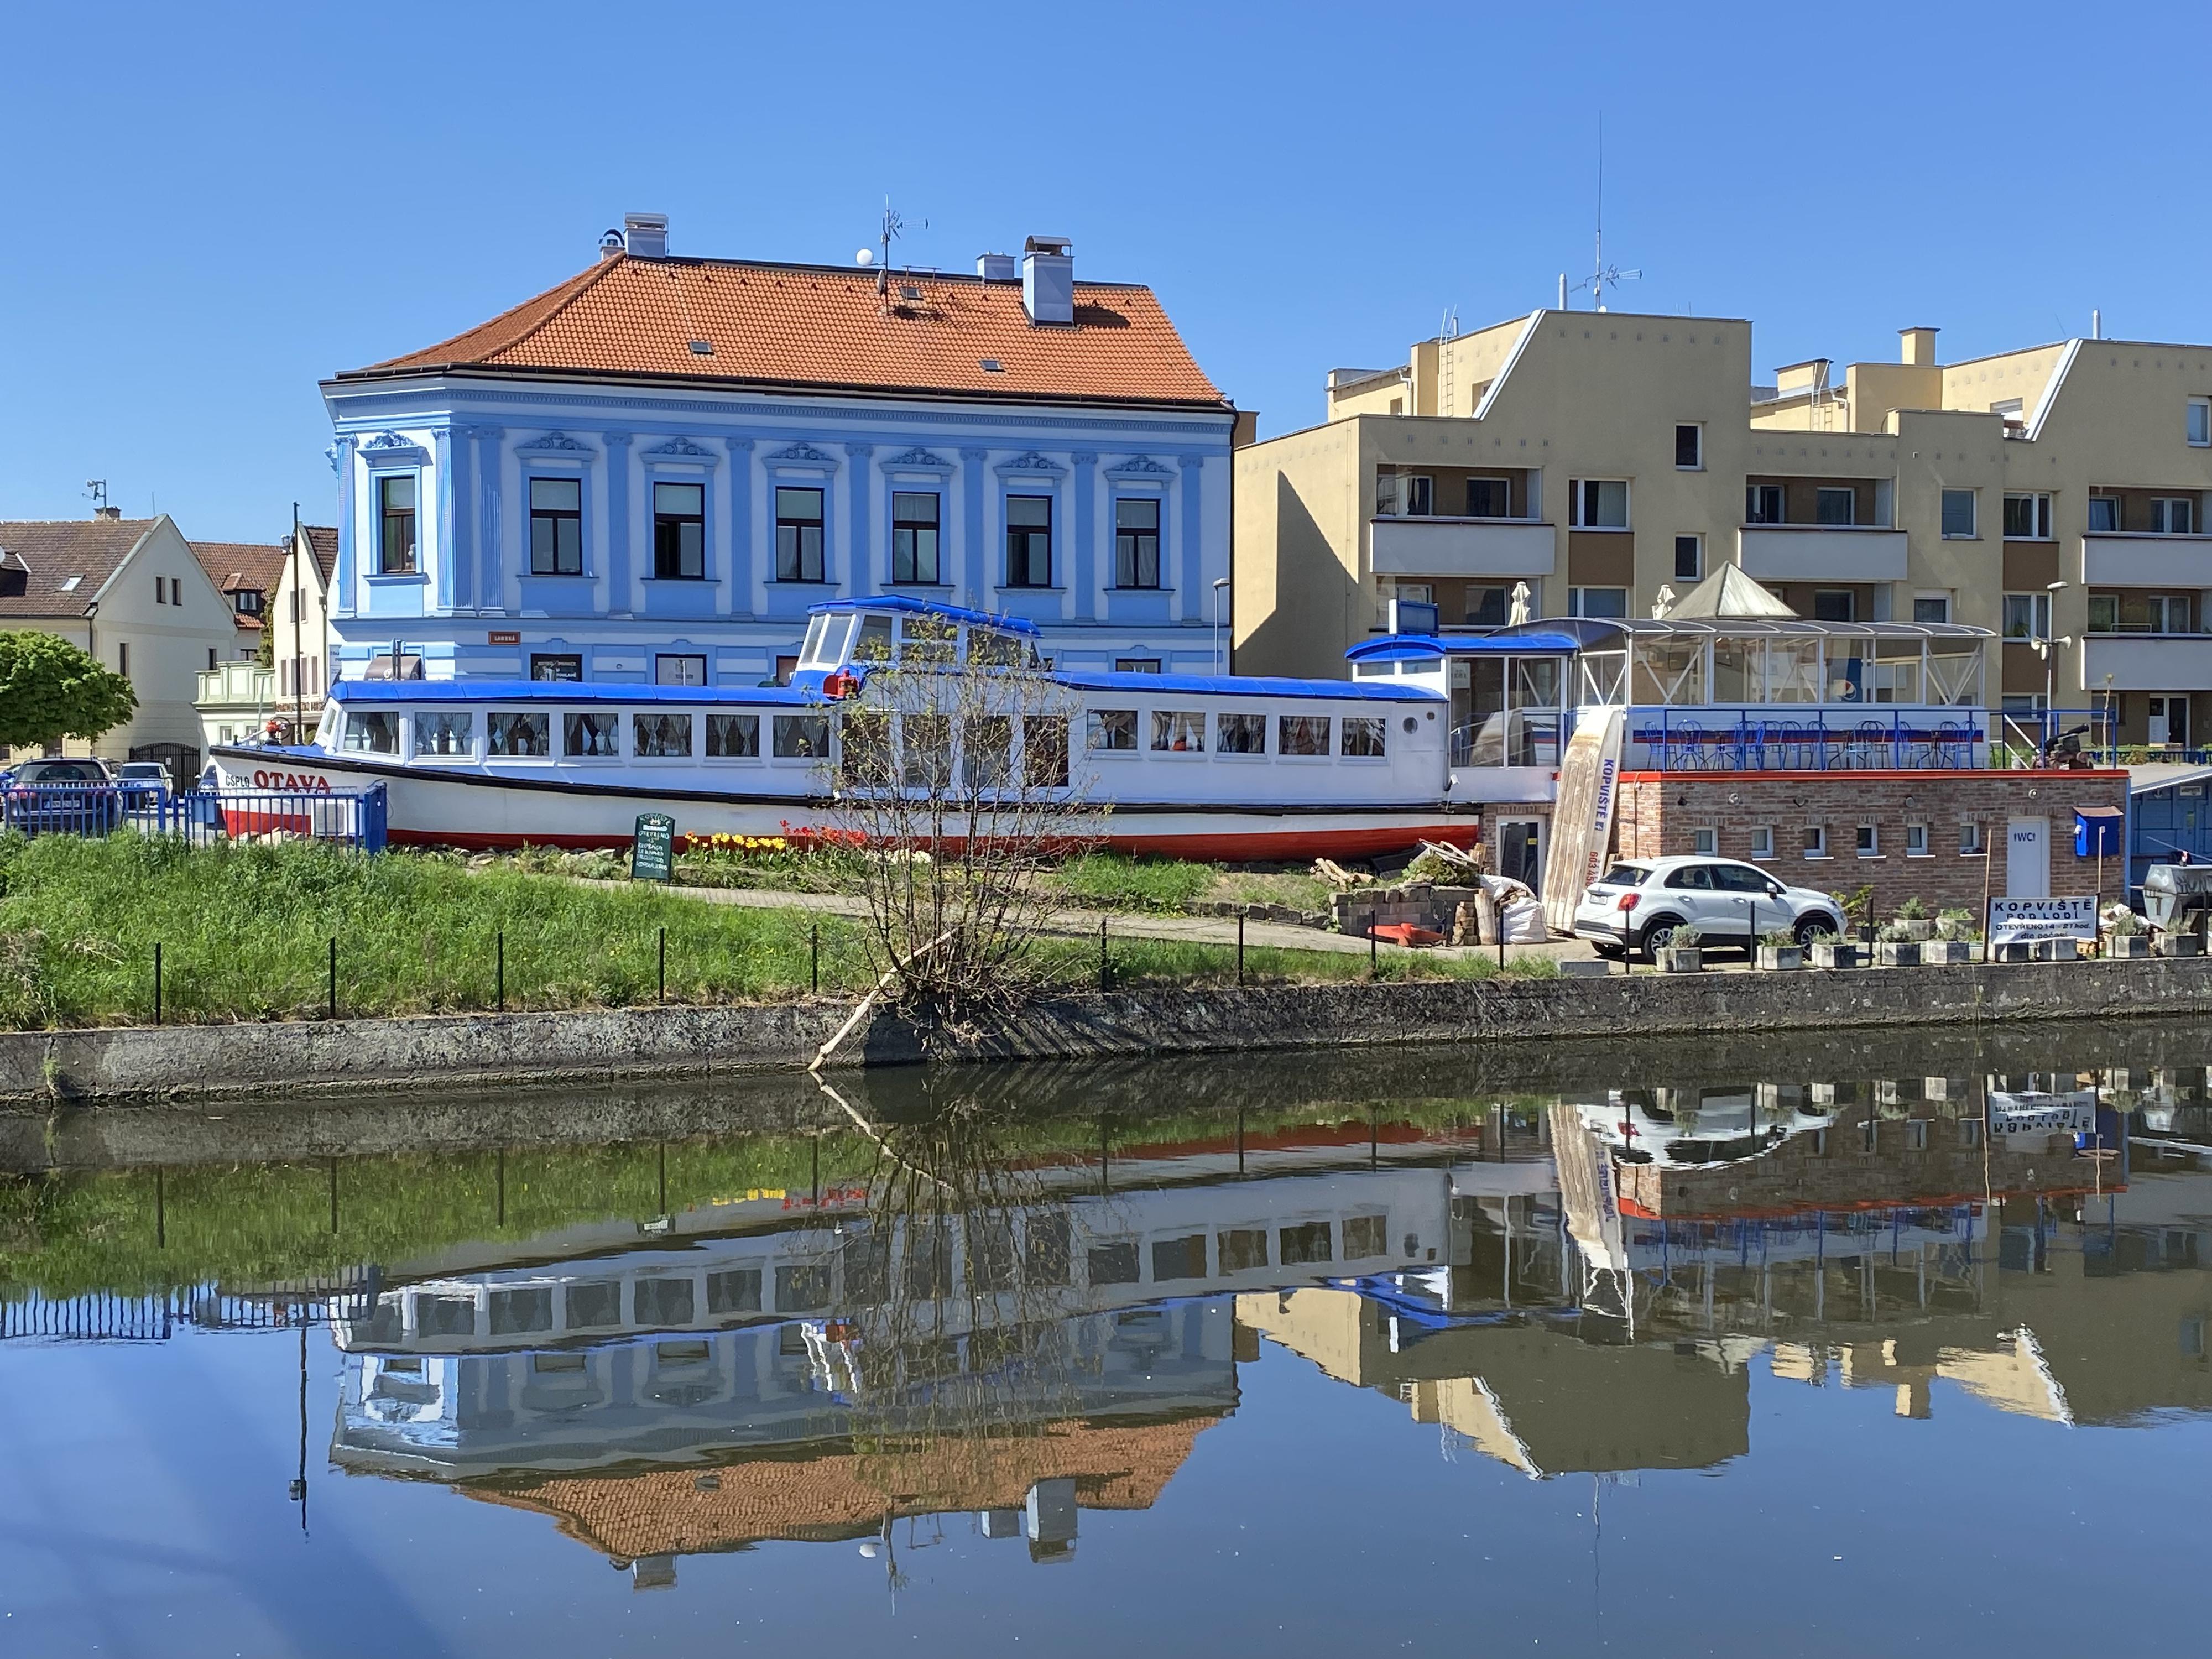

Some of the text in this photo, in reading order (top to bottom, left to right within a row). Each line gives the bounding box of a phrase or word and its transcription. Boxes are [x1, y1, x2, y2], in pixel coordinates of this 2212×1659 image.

[254, 770, 331, 795] OTAVA
[1595, 758, 1614, 820] KOPVIŠTĚ
[1588, 852, 1598, 868] 603
[1994, 898, 2092, 912] KOPVIŠTĚ
[2043, 910, 2078, 920] LODÍ
[1995, 922, 2043, 930] OTEVŘENO
